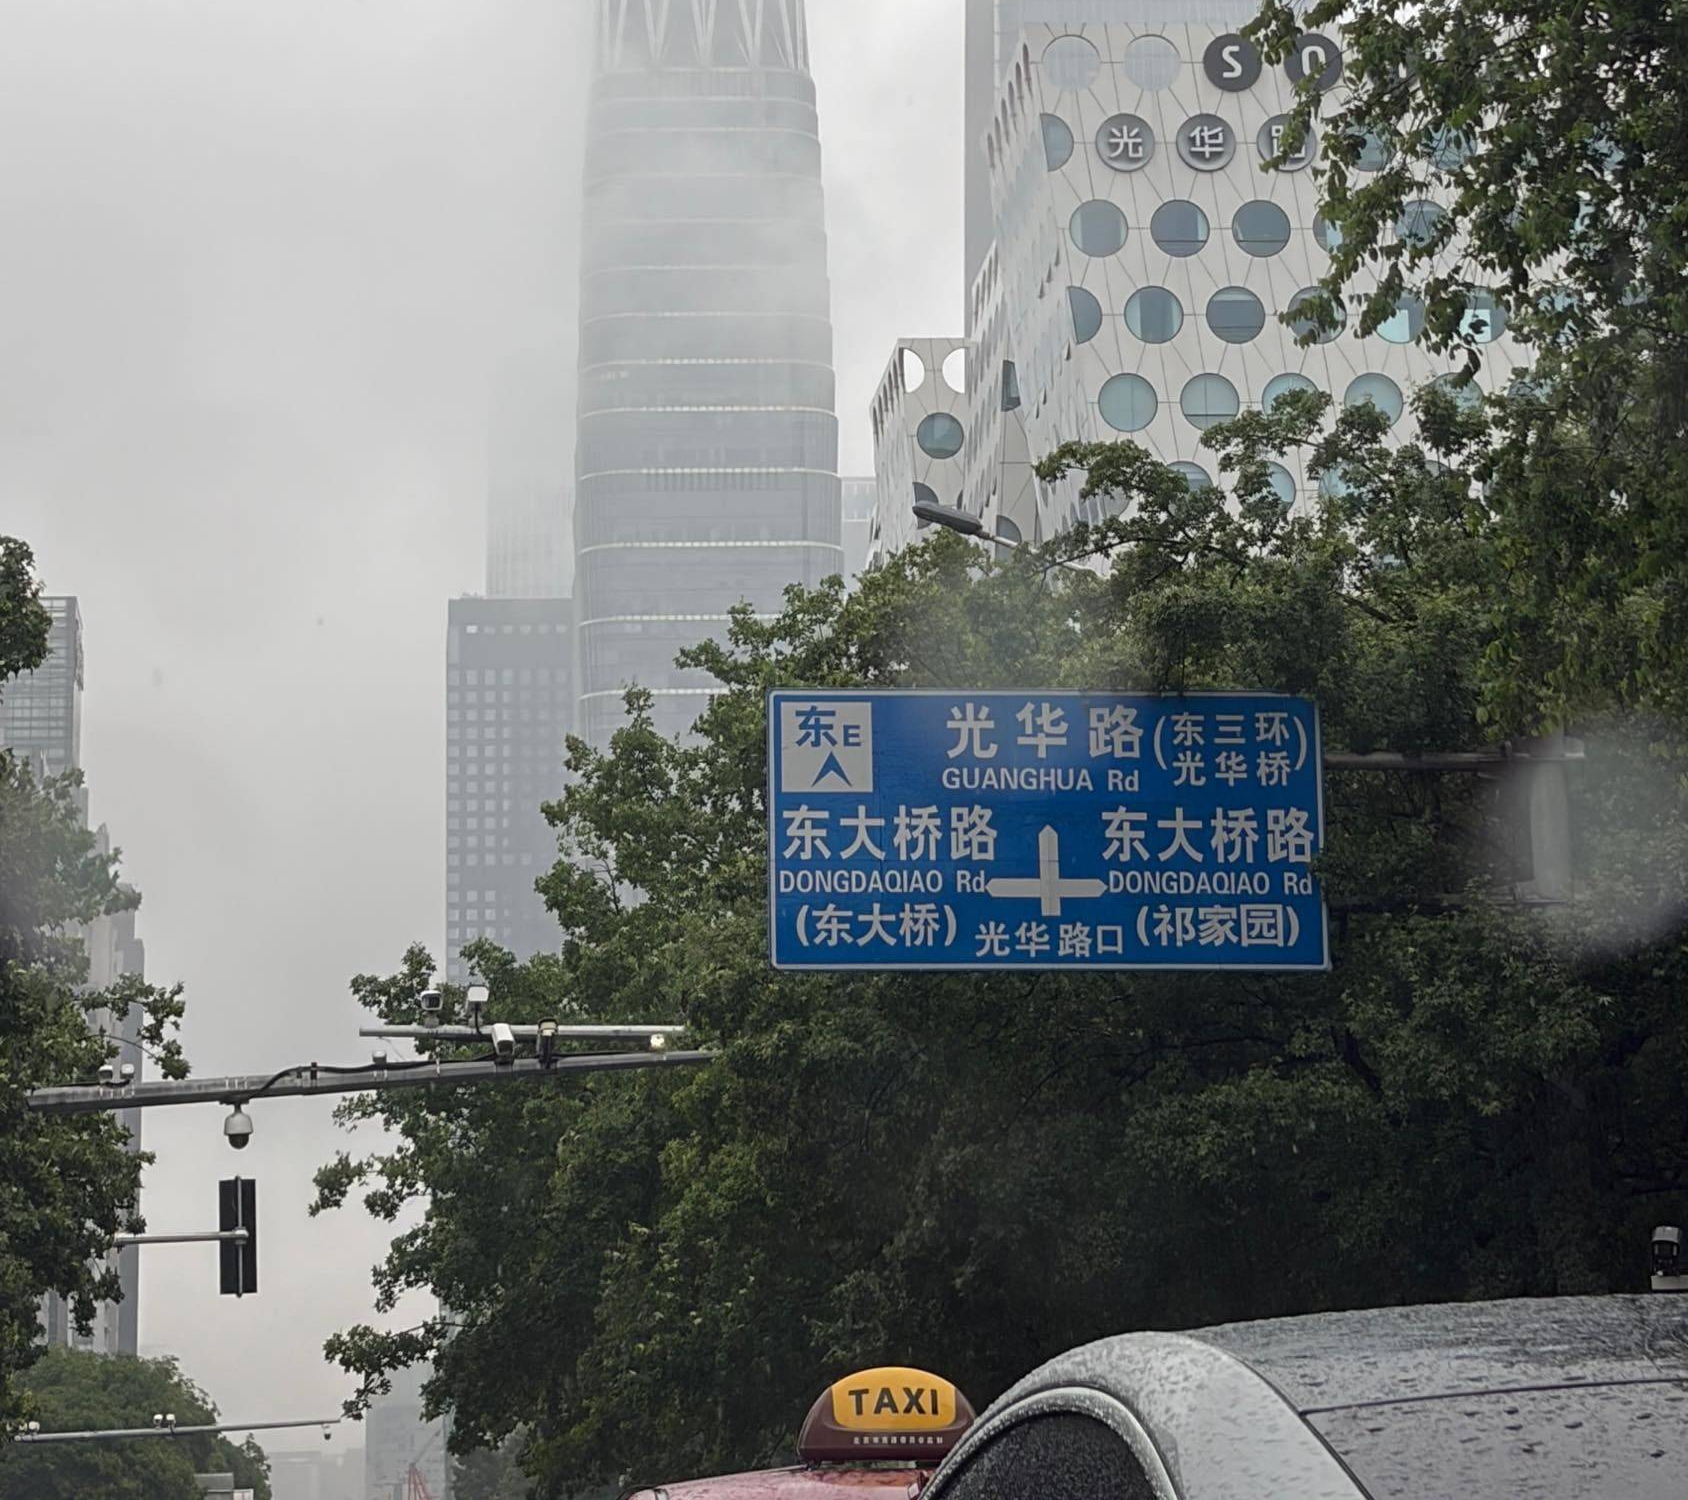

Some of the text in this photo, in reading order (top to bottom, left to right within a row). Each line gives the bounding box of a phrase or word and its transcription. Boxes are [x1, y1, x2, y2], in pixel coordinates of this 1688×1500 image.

[946, 703, 1143, 759] 光华路
[942, 768, 1140, 792] GUANGHUA Rd
[781, 805, 998, 862] 东大桥路
[1101, 807, 1314, 864] 东大桥路
[780, 870, 985, 894] DONGDAQIAO Rd
[1109, 871, 1312, 895] DONGDAQIAO Rd
[796, 903, 956, 948] (东大桥)
[975, 922, 1124, 958] 光华路口
[848, 1387, 939, 1416] TAXI
